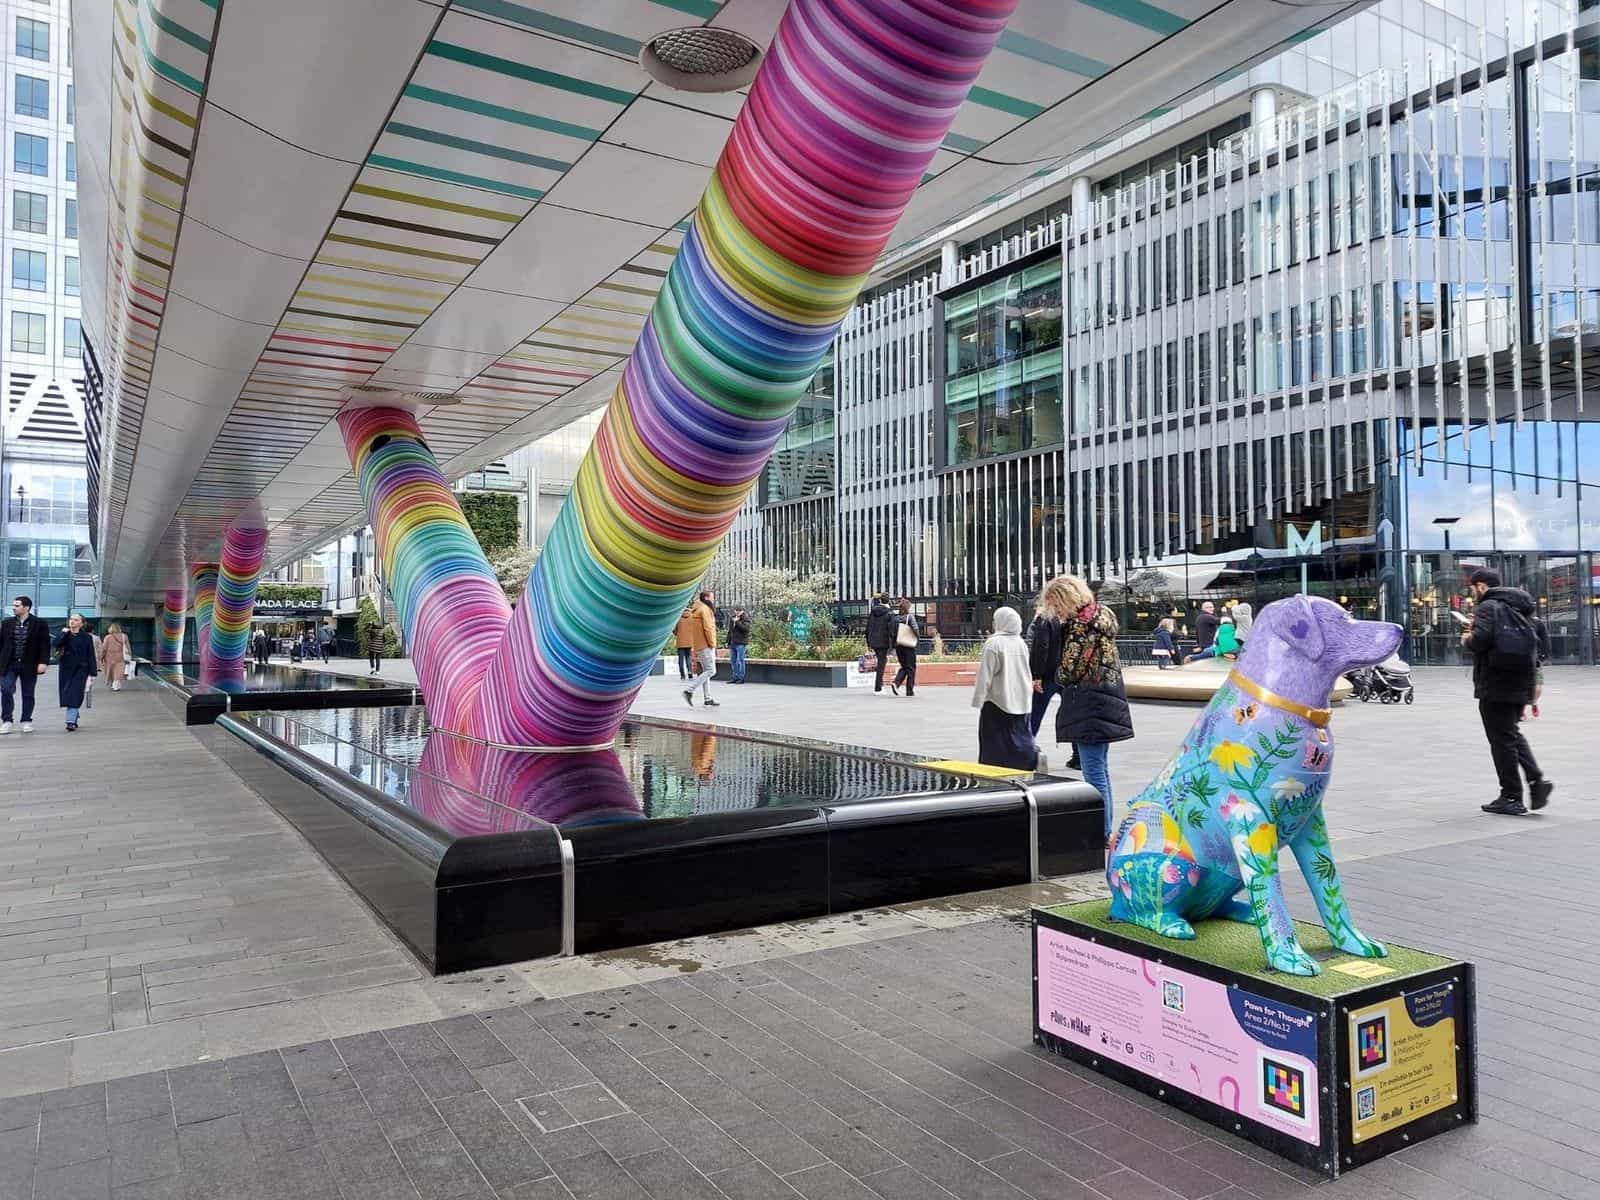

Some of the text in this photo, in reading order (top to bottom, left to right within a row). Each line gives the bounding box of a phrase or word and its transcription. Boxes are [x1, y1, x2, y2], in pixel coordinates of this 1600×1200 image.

[1288, 520, 1321, 557] M
[254, 599, 318, 608] NADA PLACE
[1243, 999, 1310, 1029] Paws for Thought
[1244, 1010, 1263, 1024] Area
